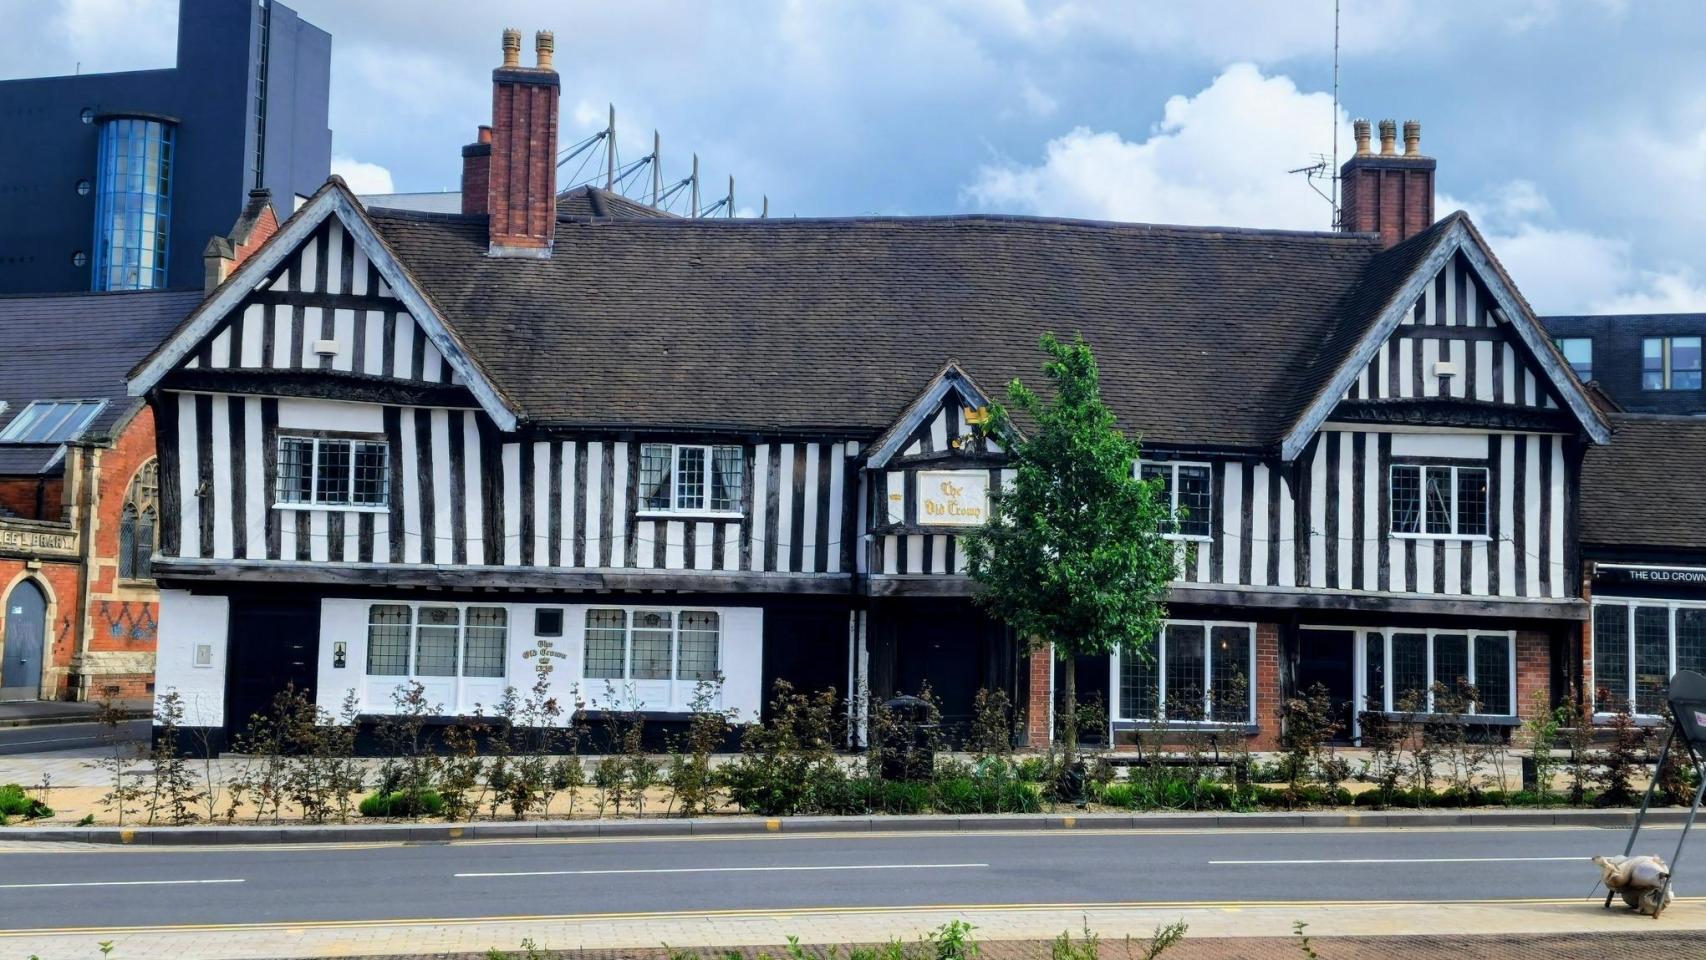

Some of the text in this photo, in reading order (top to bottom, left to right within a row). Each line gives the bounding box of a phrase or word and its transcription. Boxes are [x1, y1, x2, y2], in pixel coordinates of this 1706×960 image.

[941, 480, 964, 498] The
[925, 500, 981, 519] Old Crown
[21, 532, 74, 550] LBRARY
[1629, 571, 1706, 582] THE OLD CROWN
[537, 640, 554, 648] The
[522, 648, 567, 659] Old Crown
